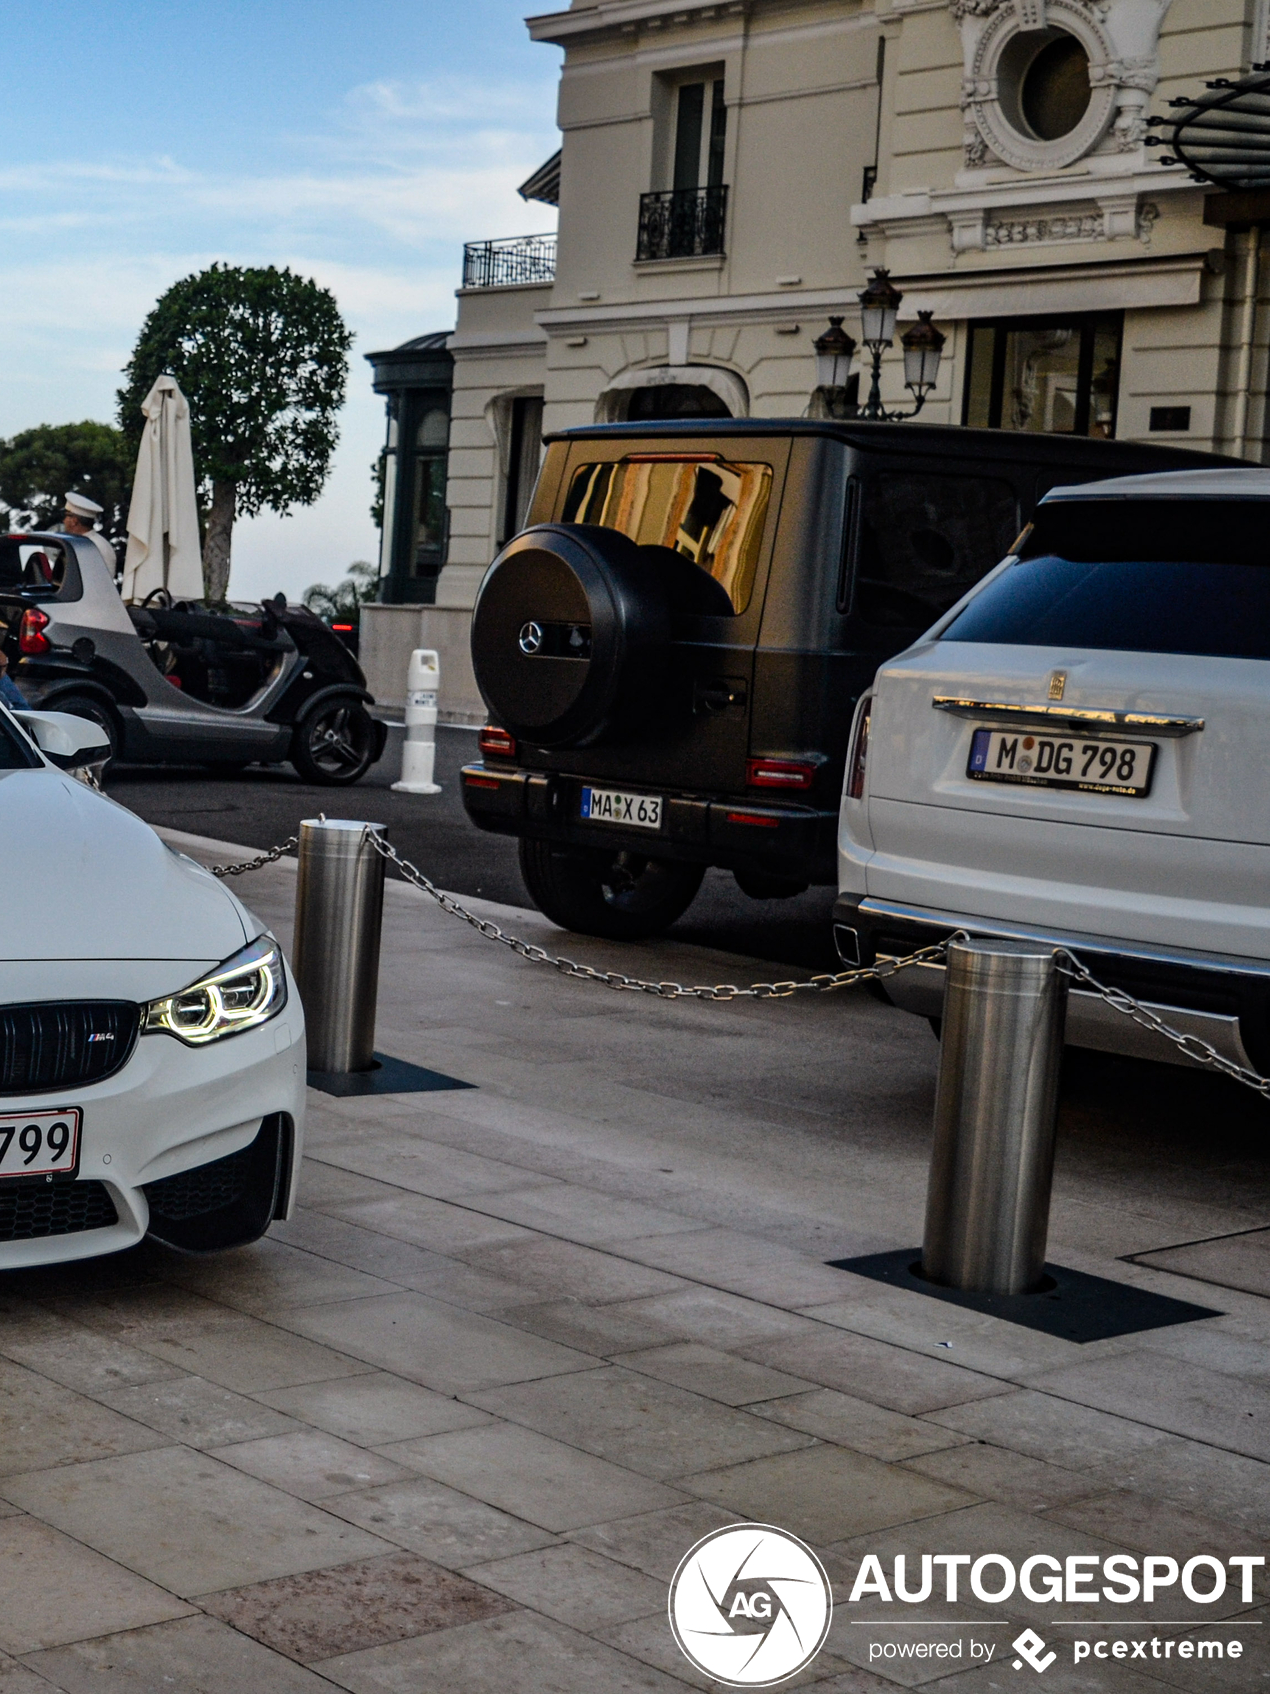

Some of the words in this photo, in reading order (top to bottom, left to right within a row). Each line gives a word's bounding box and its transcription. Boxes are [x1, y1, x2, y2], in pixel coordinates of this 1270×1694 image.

[996, 737, 1018, 769] M
[1033, 740, 1074, 775] DG
[1080, 744, 1136, 781] 798
[591, 793, 612, 817] MA
[623, 797, 633, 820] X
[637, 800, 659, 823] 63
